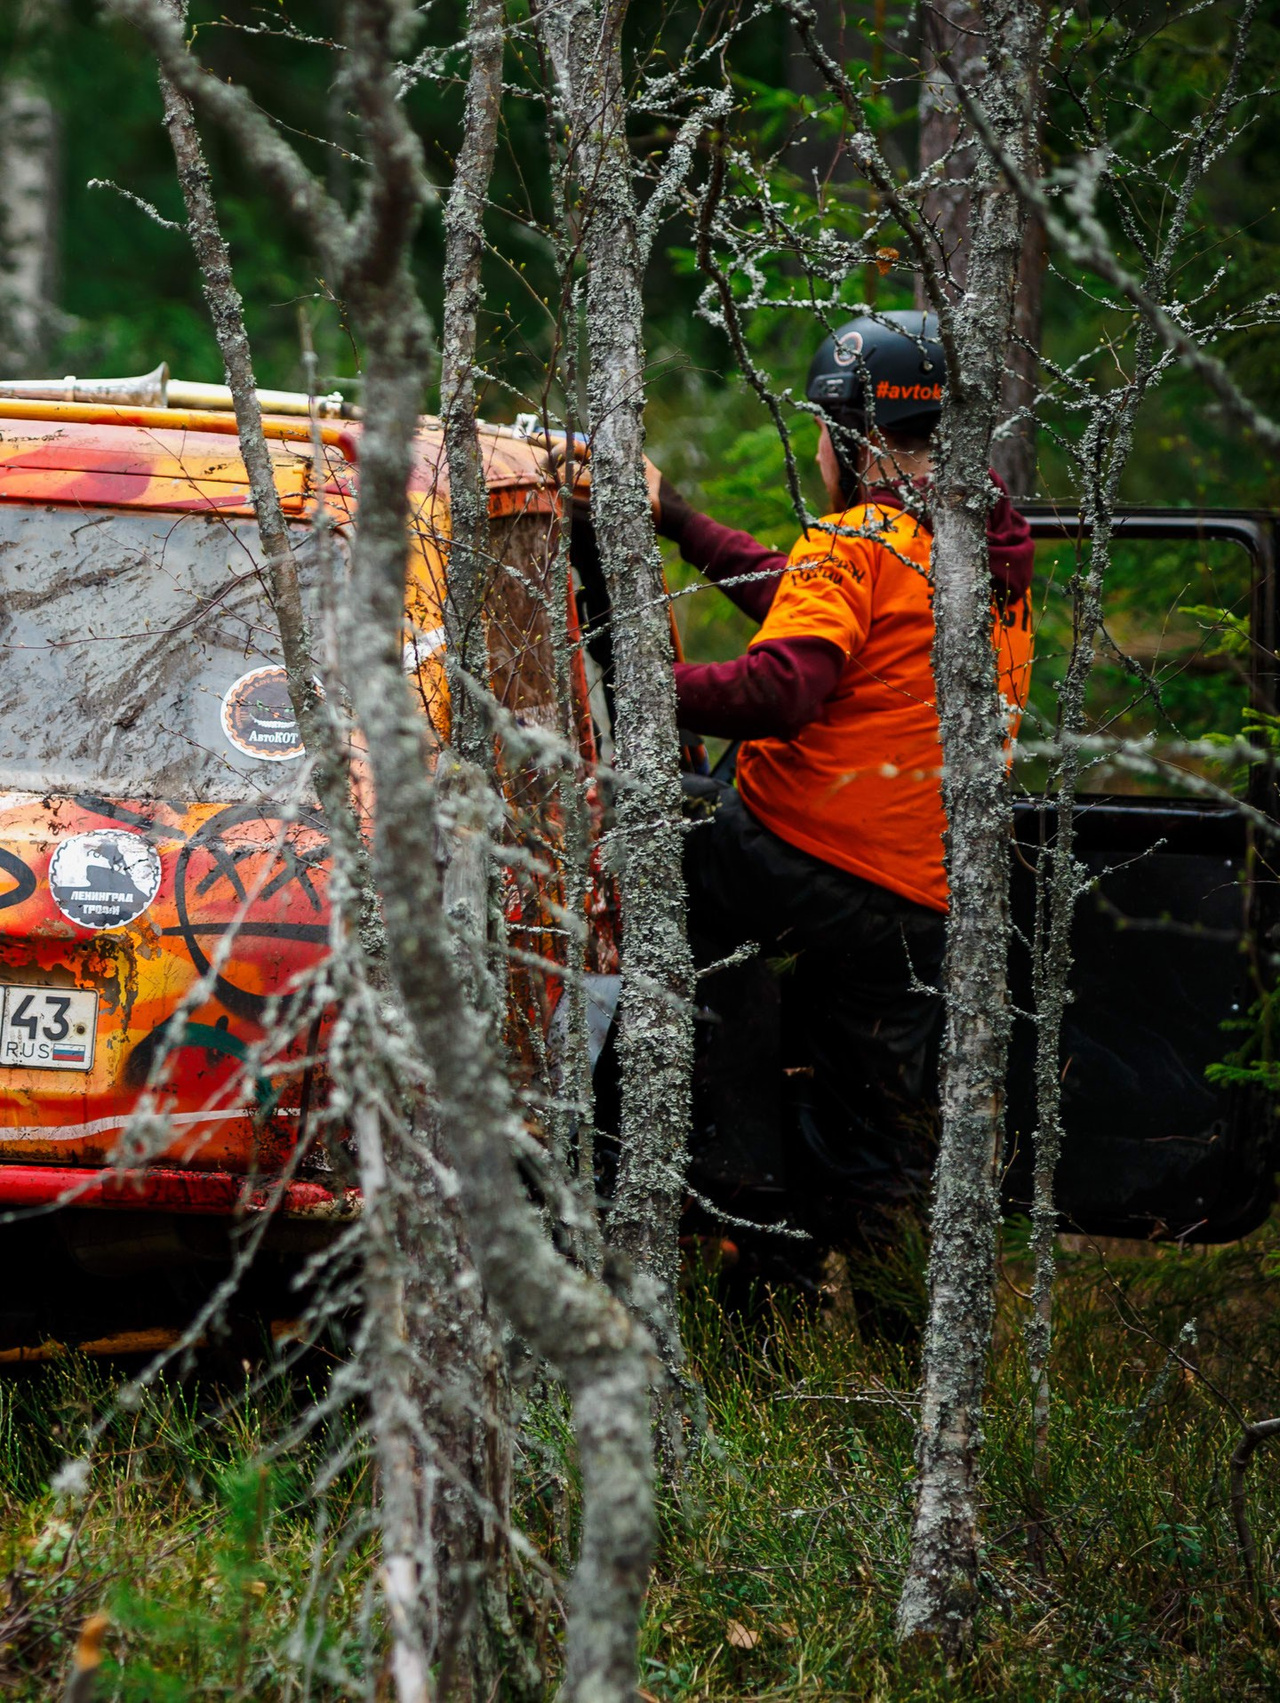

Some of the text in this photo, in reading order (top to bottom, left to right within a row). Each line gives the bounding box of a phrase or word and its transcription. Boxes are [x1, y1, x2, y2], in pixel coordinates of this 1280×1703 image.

[70, 890, 134, 903] ЛЕНИНГРАД
[10, 994, 71, 1041] 43
[5, 1041, 50, 1059] RUS
